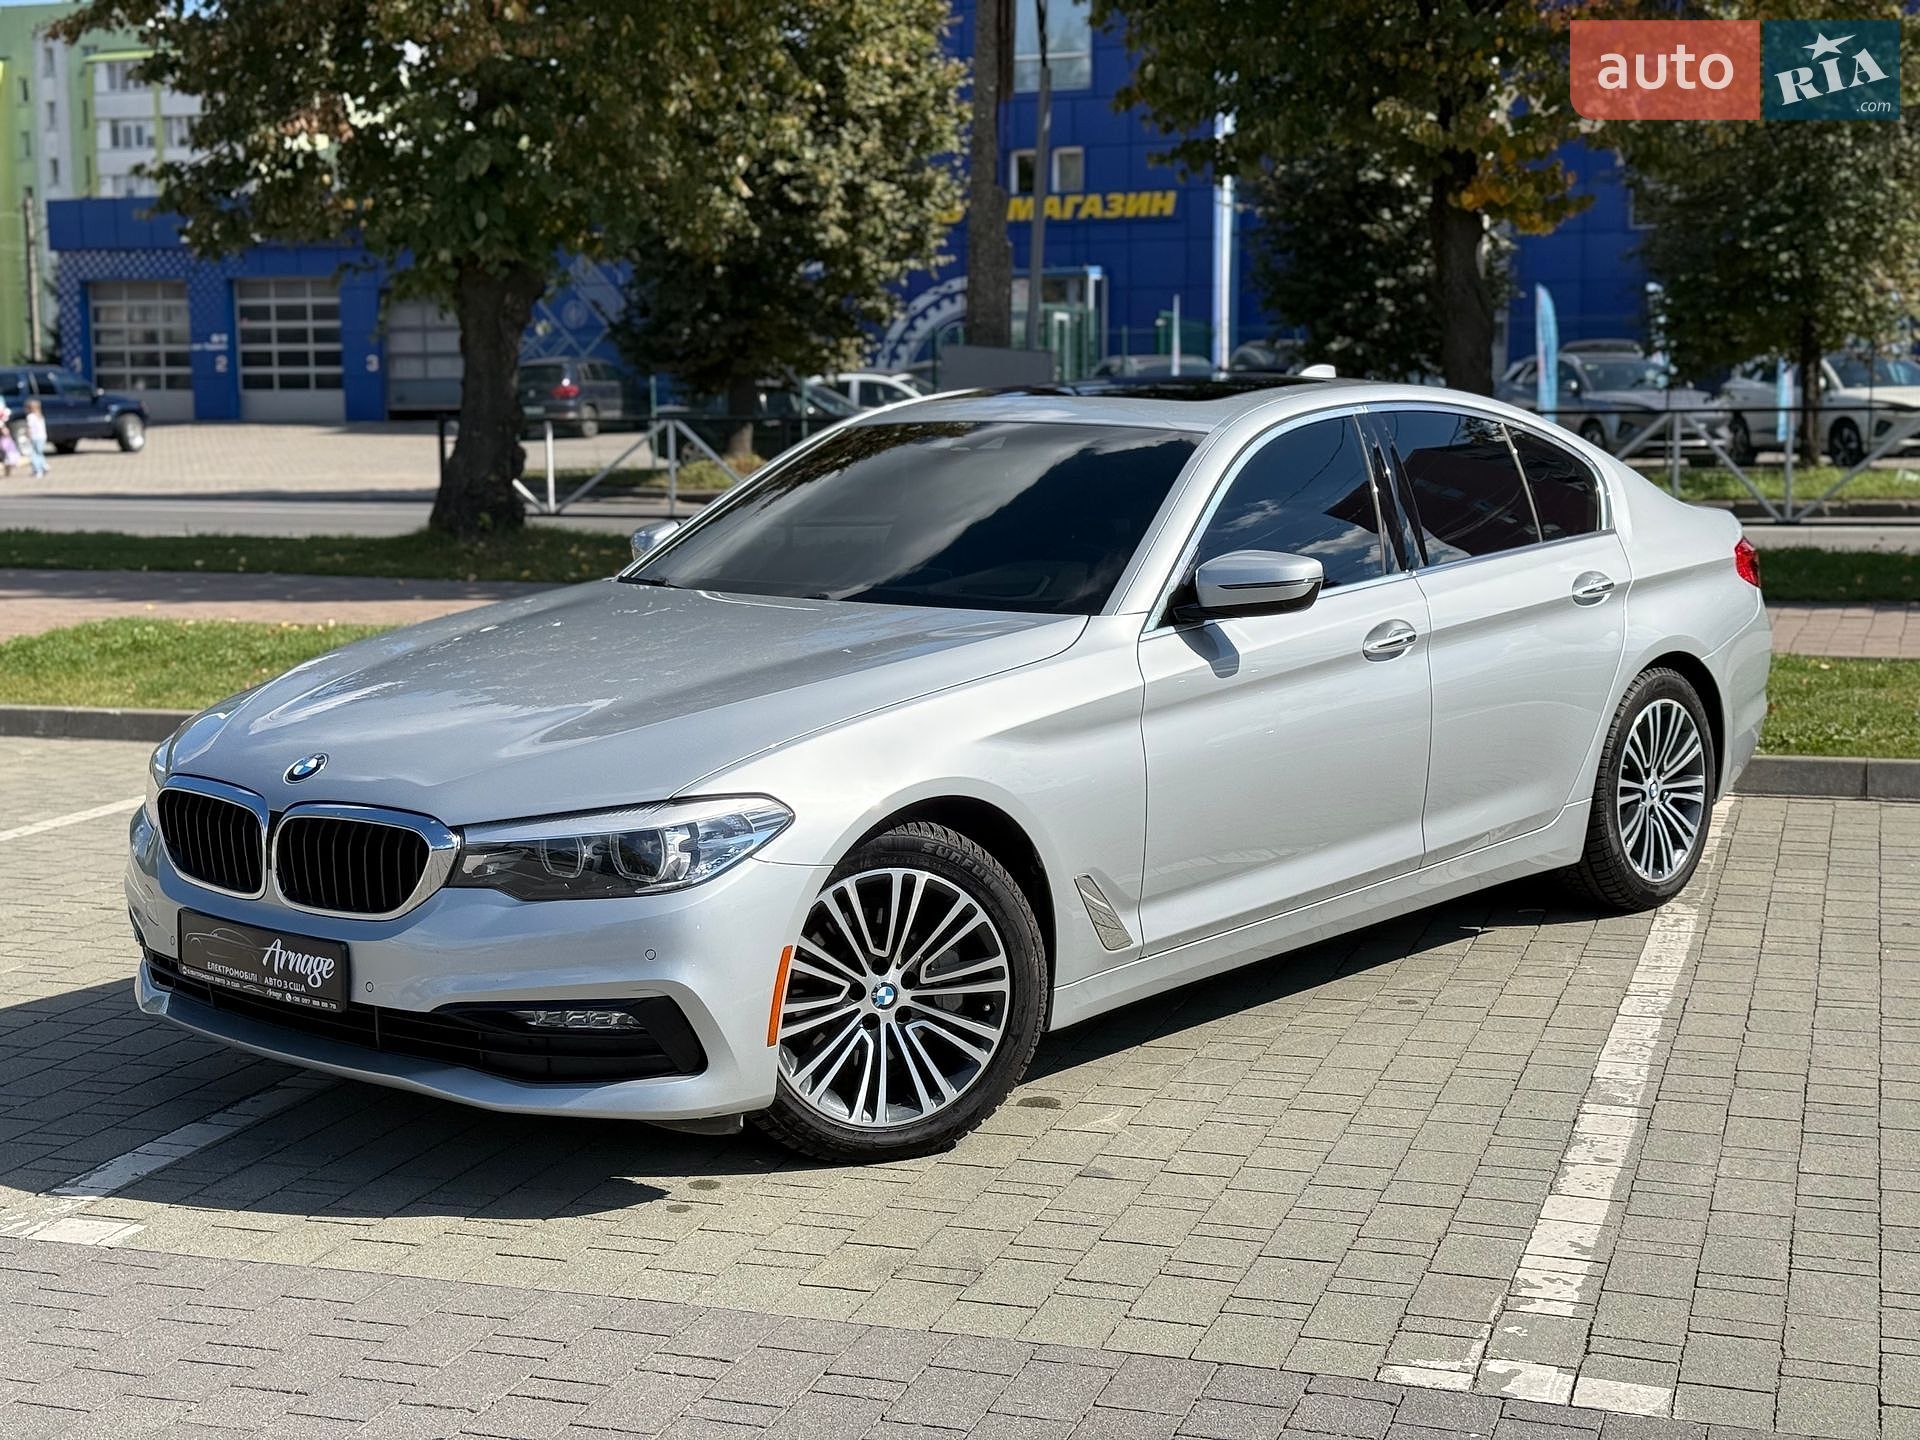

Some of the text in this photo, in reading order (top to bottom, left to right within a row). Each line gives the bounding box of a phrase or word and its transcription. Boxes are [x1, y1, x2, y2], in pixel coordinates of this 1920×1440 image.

[215, 354, 228, 373] 2
[366, 353, 379, 372] 3
[207, 961, 258, 983] ЕЛЕКТРОМОБІЛІ
[262, 938, 335, 988] Arnage
[264, 976, 283, 988] АВТО
[289, 982, 306, 993] США
